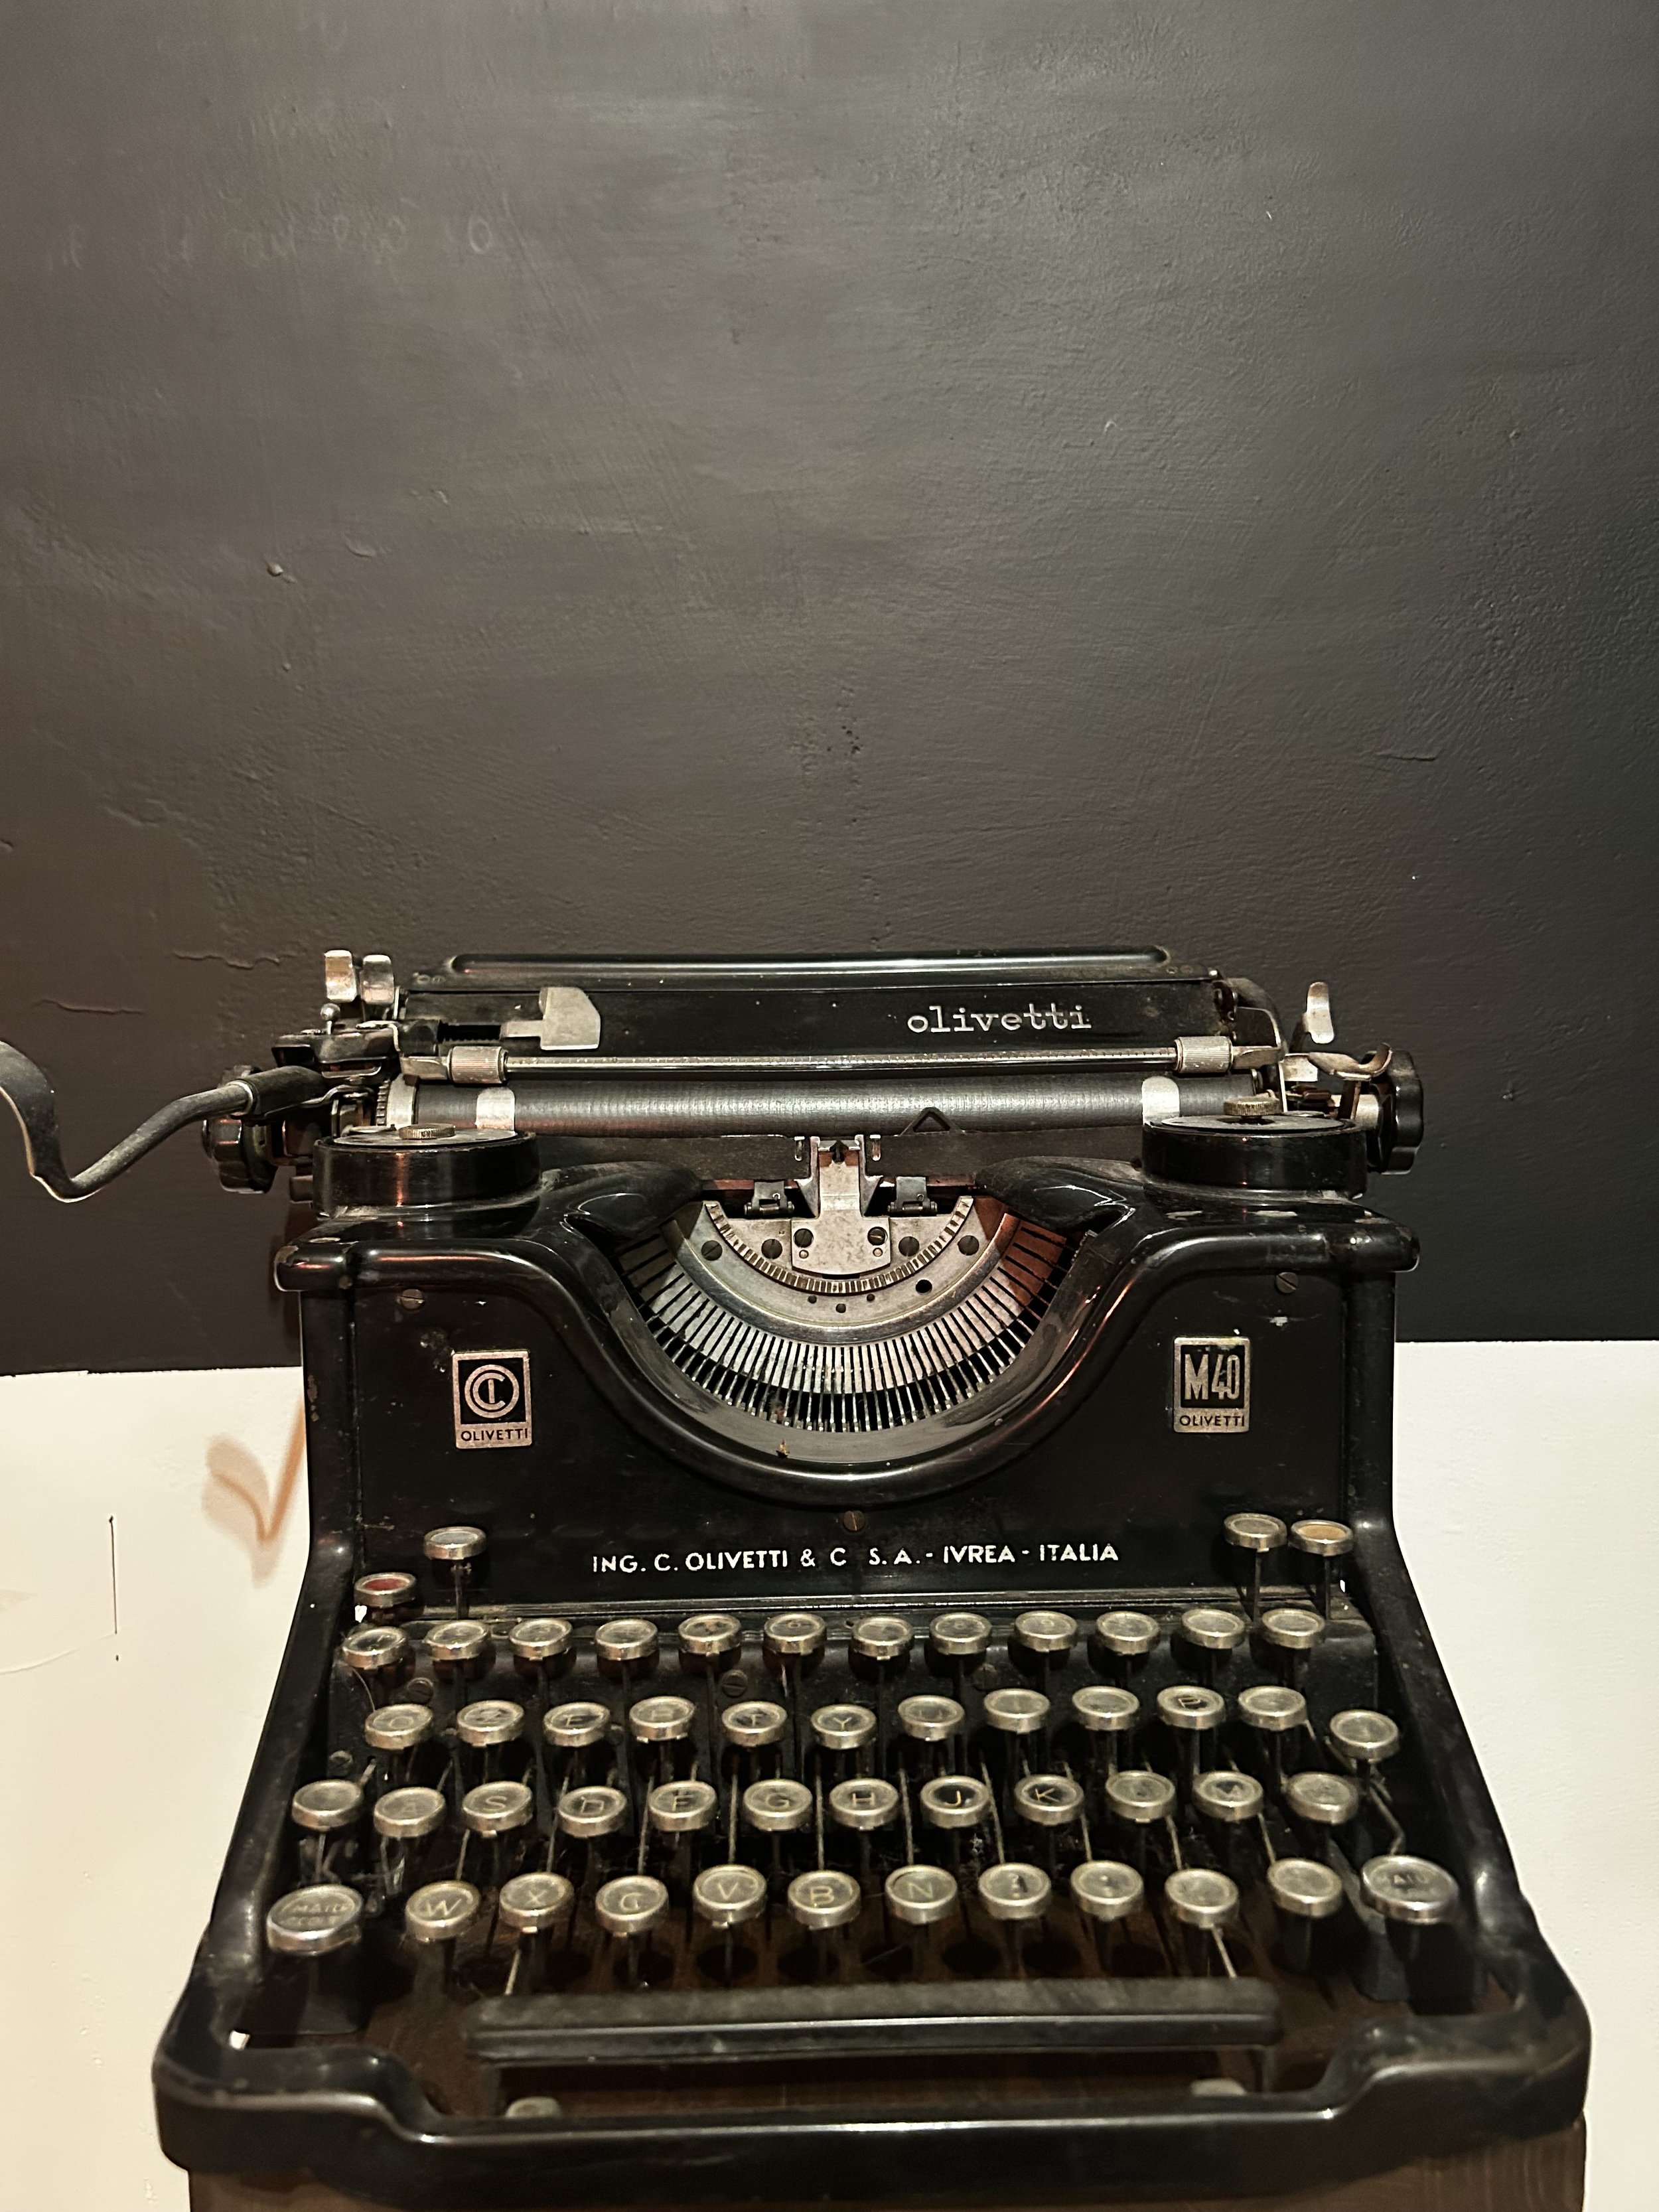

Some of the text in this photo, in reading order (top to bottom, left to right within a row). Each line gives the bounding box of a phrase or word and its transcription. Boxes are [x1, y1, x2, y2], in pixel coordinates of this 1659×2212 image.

[907, 1003, 1092, 1033] olivetti
[1185, 1354, 1240, 1400] M40
[461, 1428, 528, 1441] OLIVETTI
[1179, 1415, 1245, 1427] OLIVETTI
[593, 1554, 646, 1574] ING.
[654, 1553, 678, 1572] C.
[685, 1550, 788, 1572] OLIVETTI
[800, 1548, 816, 1567] &
[943, 1544, 1015, 1564] IVREA
[1039, 1543, 1119, 1562] ITALIA
[832, 1716, 852, 1731] Y
[1177, 1697, 1201, 1709] P
[483, 1795, 507, 1811] S
[580, 1799, 605, 1814] D
[852, 1792, 875, 1808] H
[944, 1790, 962, 1806] J
[1035, 1787, 1060, 1803] K
[427, 1898, 462, 1917] W
[524, 1889, 547, 1906] X
[717, 1881, 739, 1900] V
[810, 1885, 834, 1907] B
[907, 1882, 934, 1899] N
